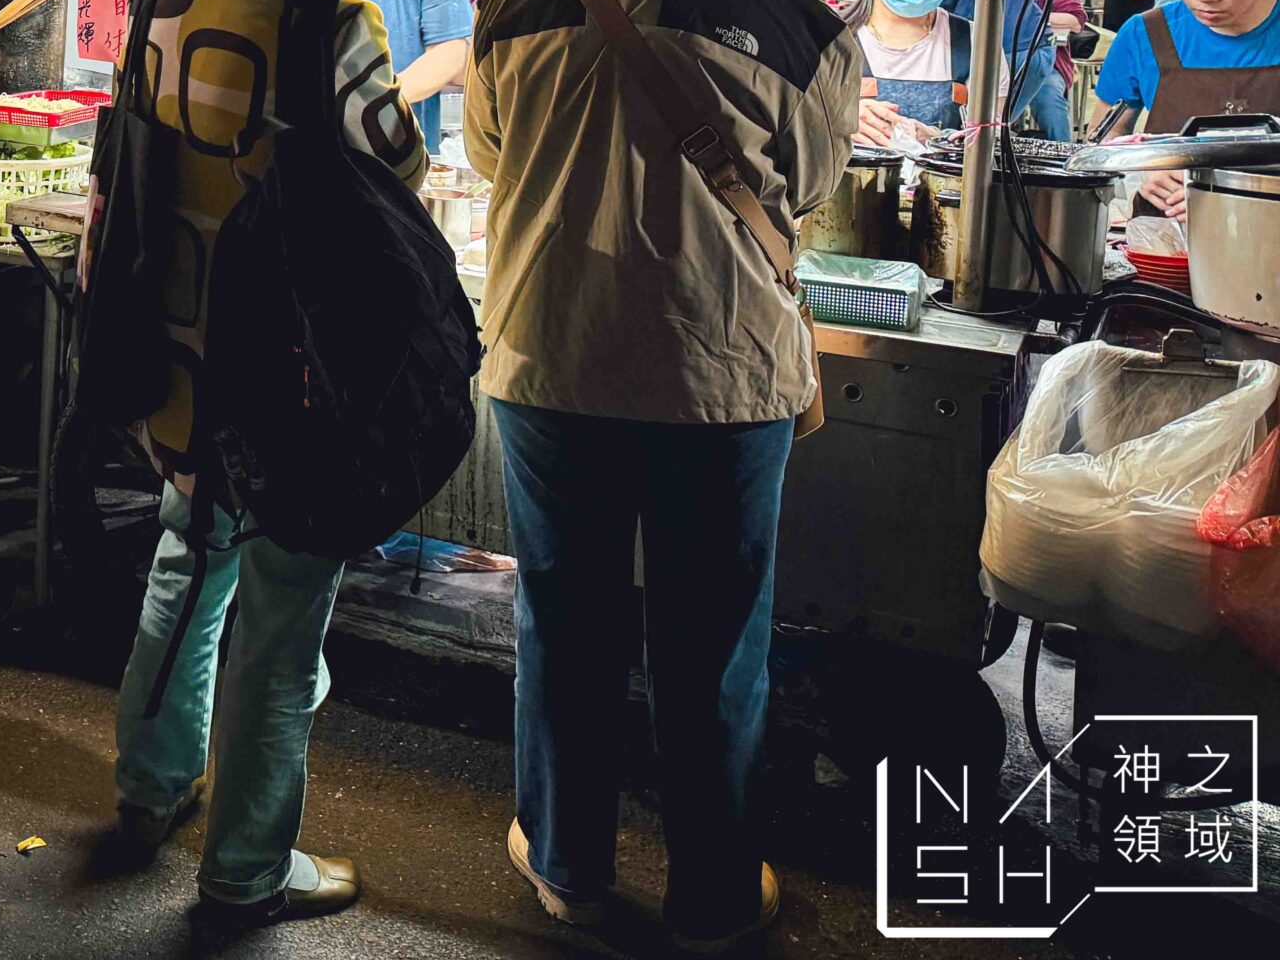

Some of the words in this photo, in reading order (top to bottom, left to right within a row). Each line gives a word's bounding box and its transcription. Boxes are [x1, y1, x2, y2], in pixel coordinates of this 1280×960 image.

[715, 26, 747, 43] NORTH
[731, 25, 748, 38] THE
[721, 36, 744, 50] FACE
